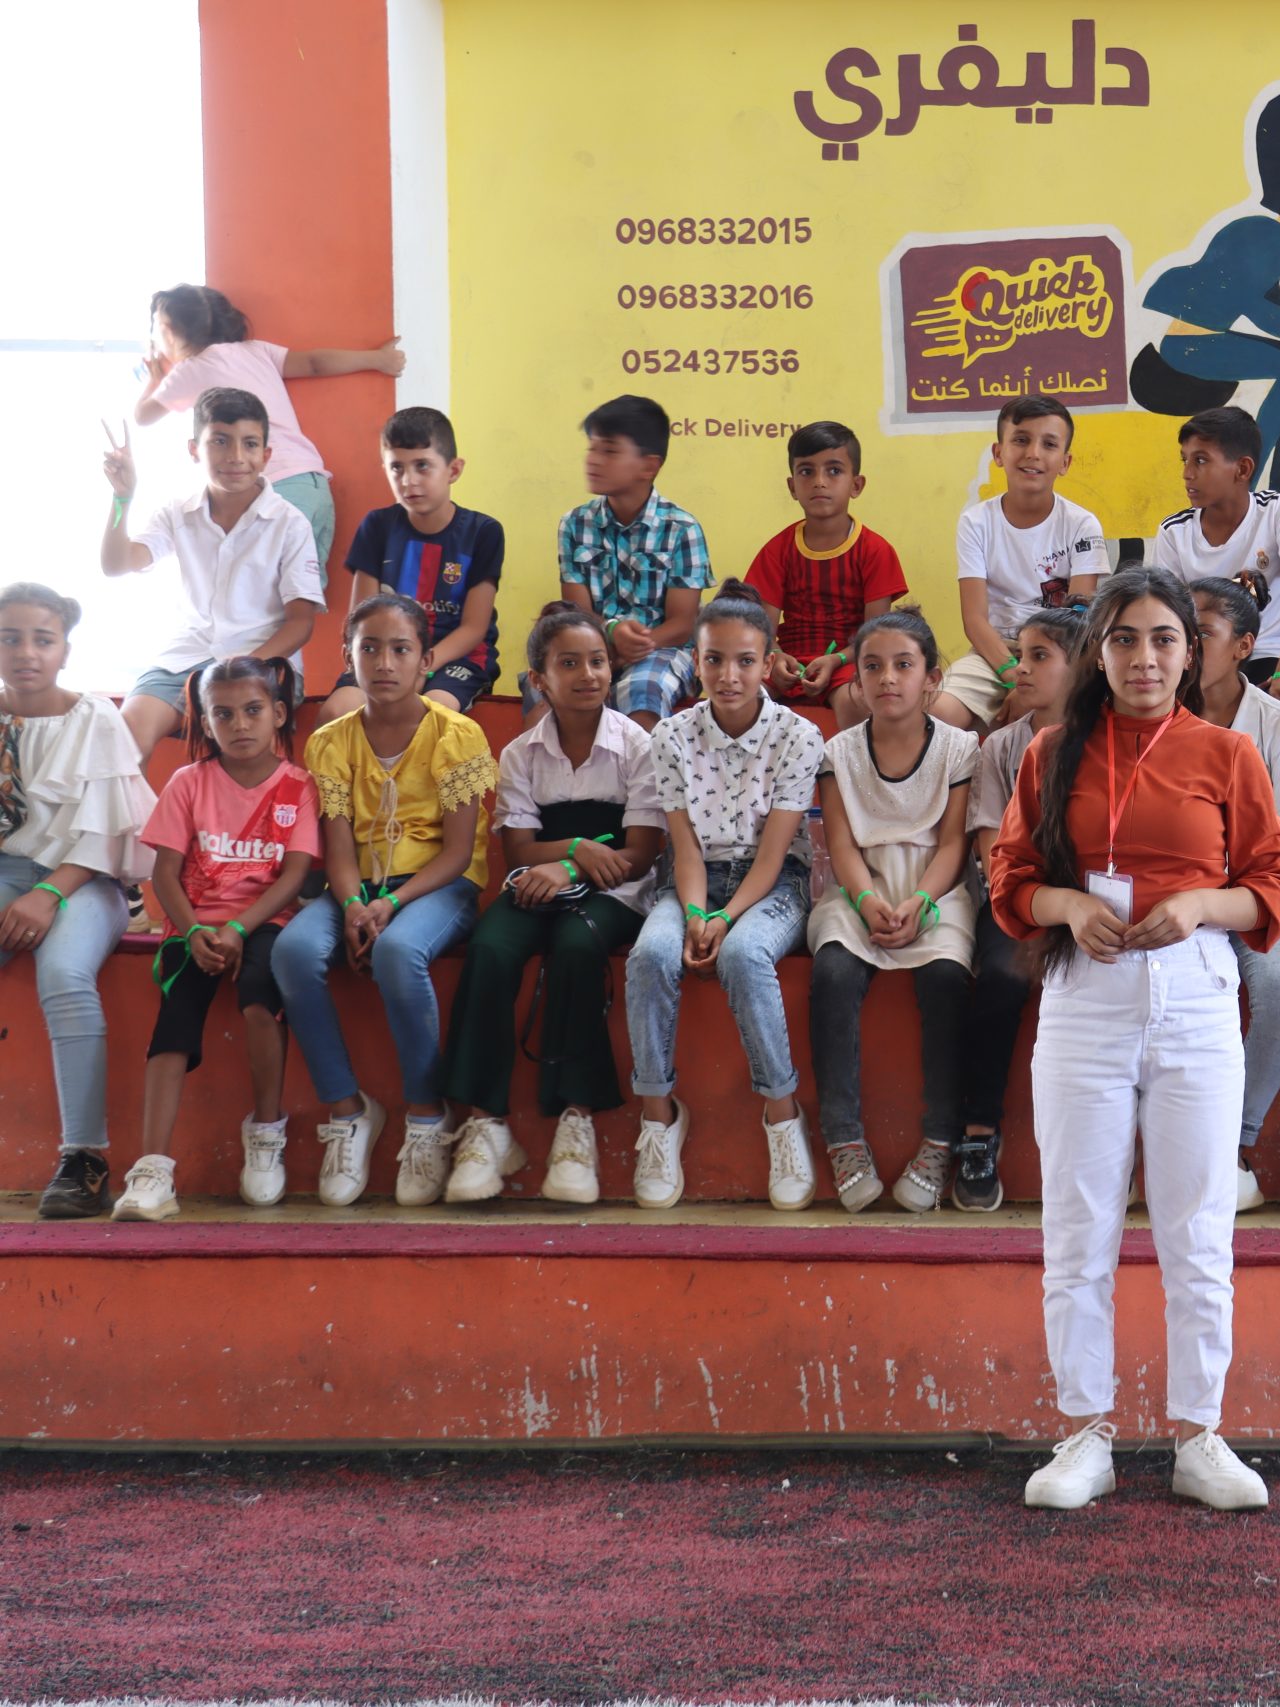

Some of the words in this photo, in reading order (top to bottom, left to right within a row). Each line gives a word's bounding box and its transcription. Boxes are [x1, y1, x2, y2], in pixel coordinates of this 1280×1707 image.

[793, 19, 1150, 161] دليفري
[616, 217, 812, 245] 0968332015
[617, 284, 814, 310] 0968332016
[1014, 297, 1108, 332] delivery
[622, 349, 800, 376] 052437536
[911, 377, 970, 401] كنت
[1039, 368, 1108, 394] نصلك
[422, 599, 461, 615] otify
